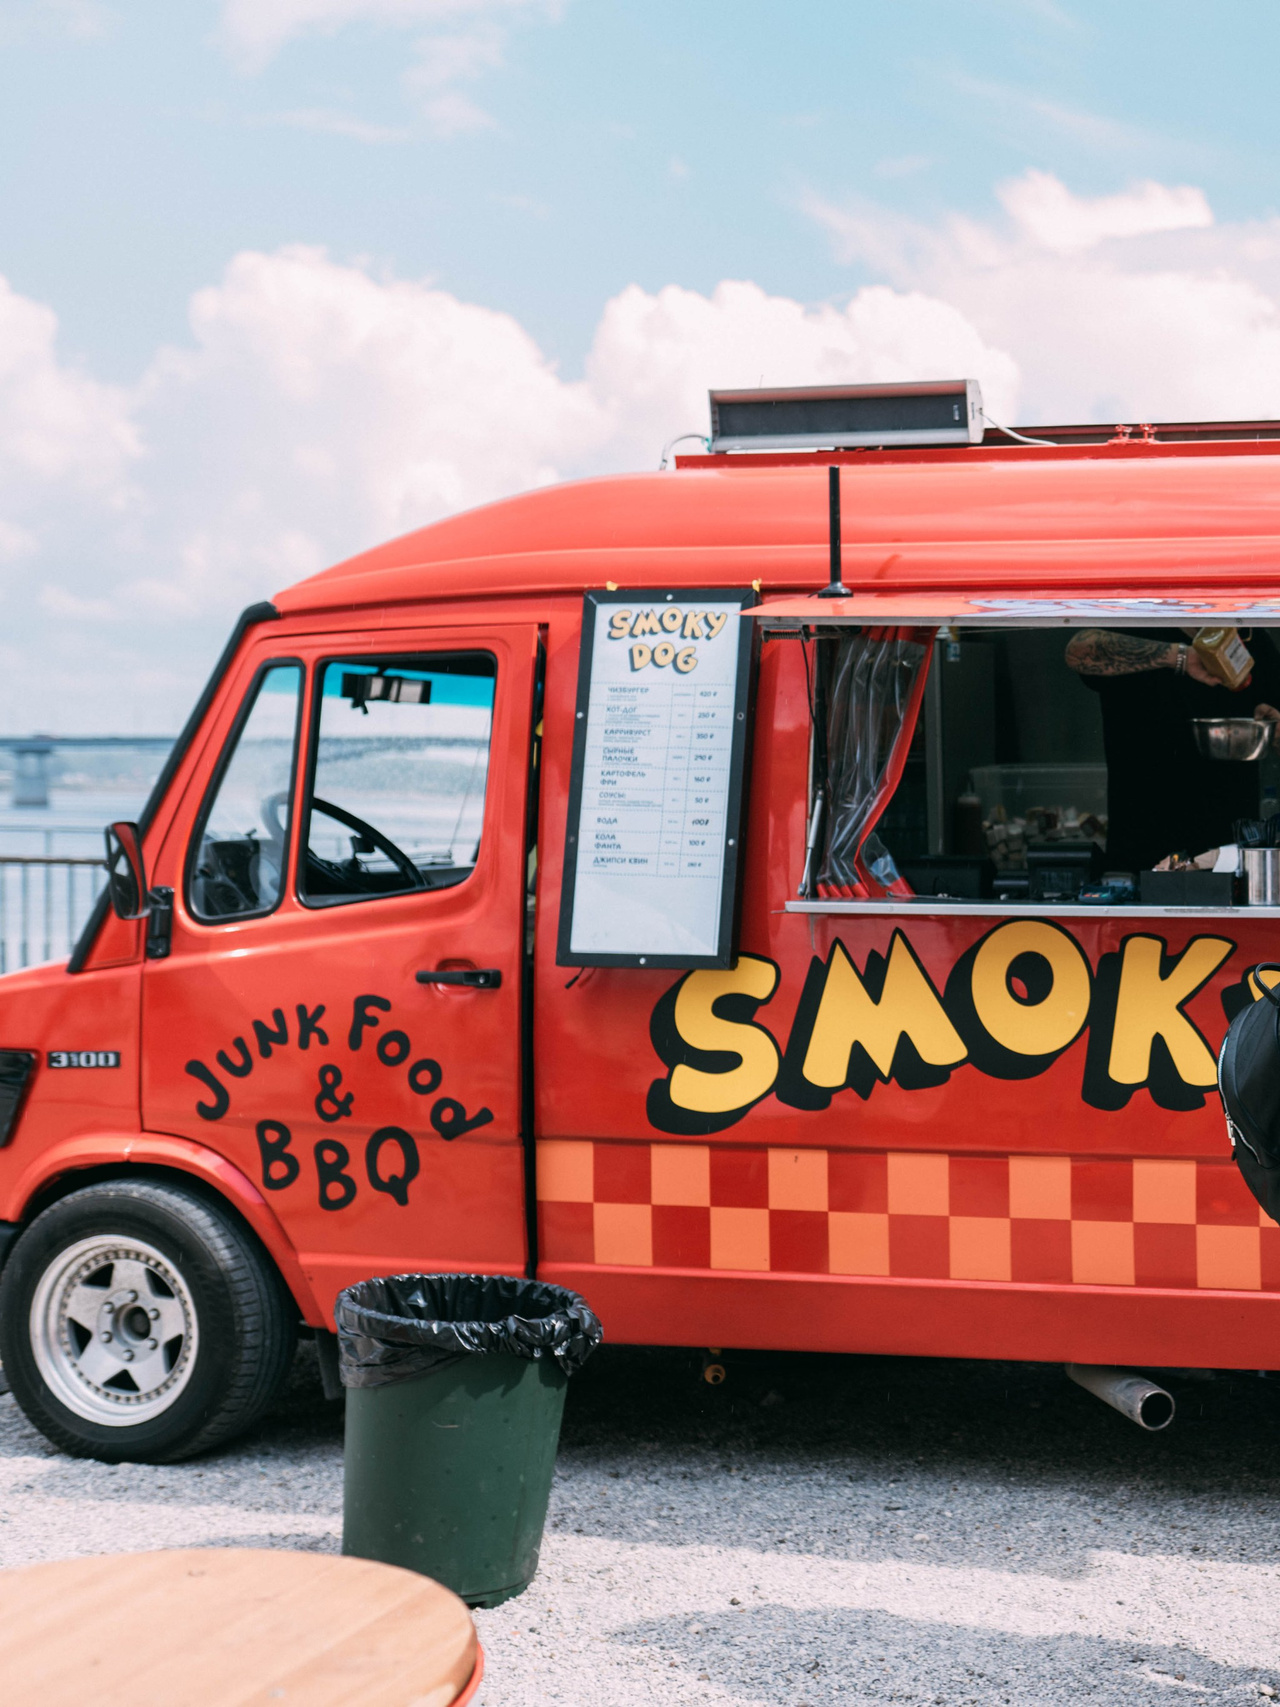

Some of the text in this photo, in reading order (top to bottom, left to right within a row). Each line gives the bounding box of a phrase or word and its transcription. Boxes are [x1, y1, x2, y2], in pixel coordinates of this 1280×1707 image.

[607, 606, 727, 640] SMOKY
[628, 641, 698, 674] DOG
[596, 817, 617, 825] ВОДА
[315, 1064, 354, 1122] &
[256, 1119, 420, 1211] BBQ
